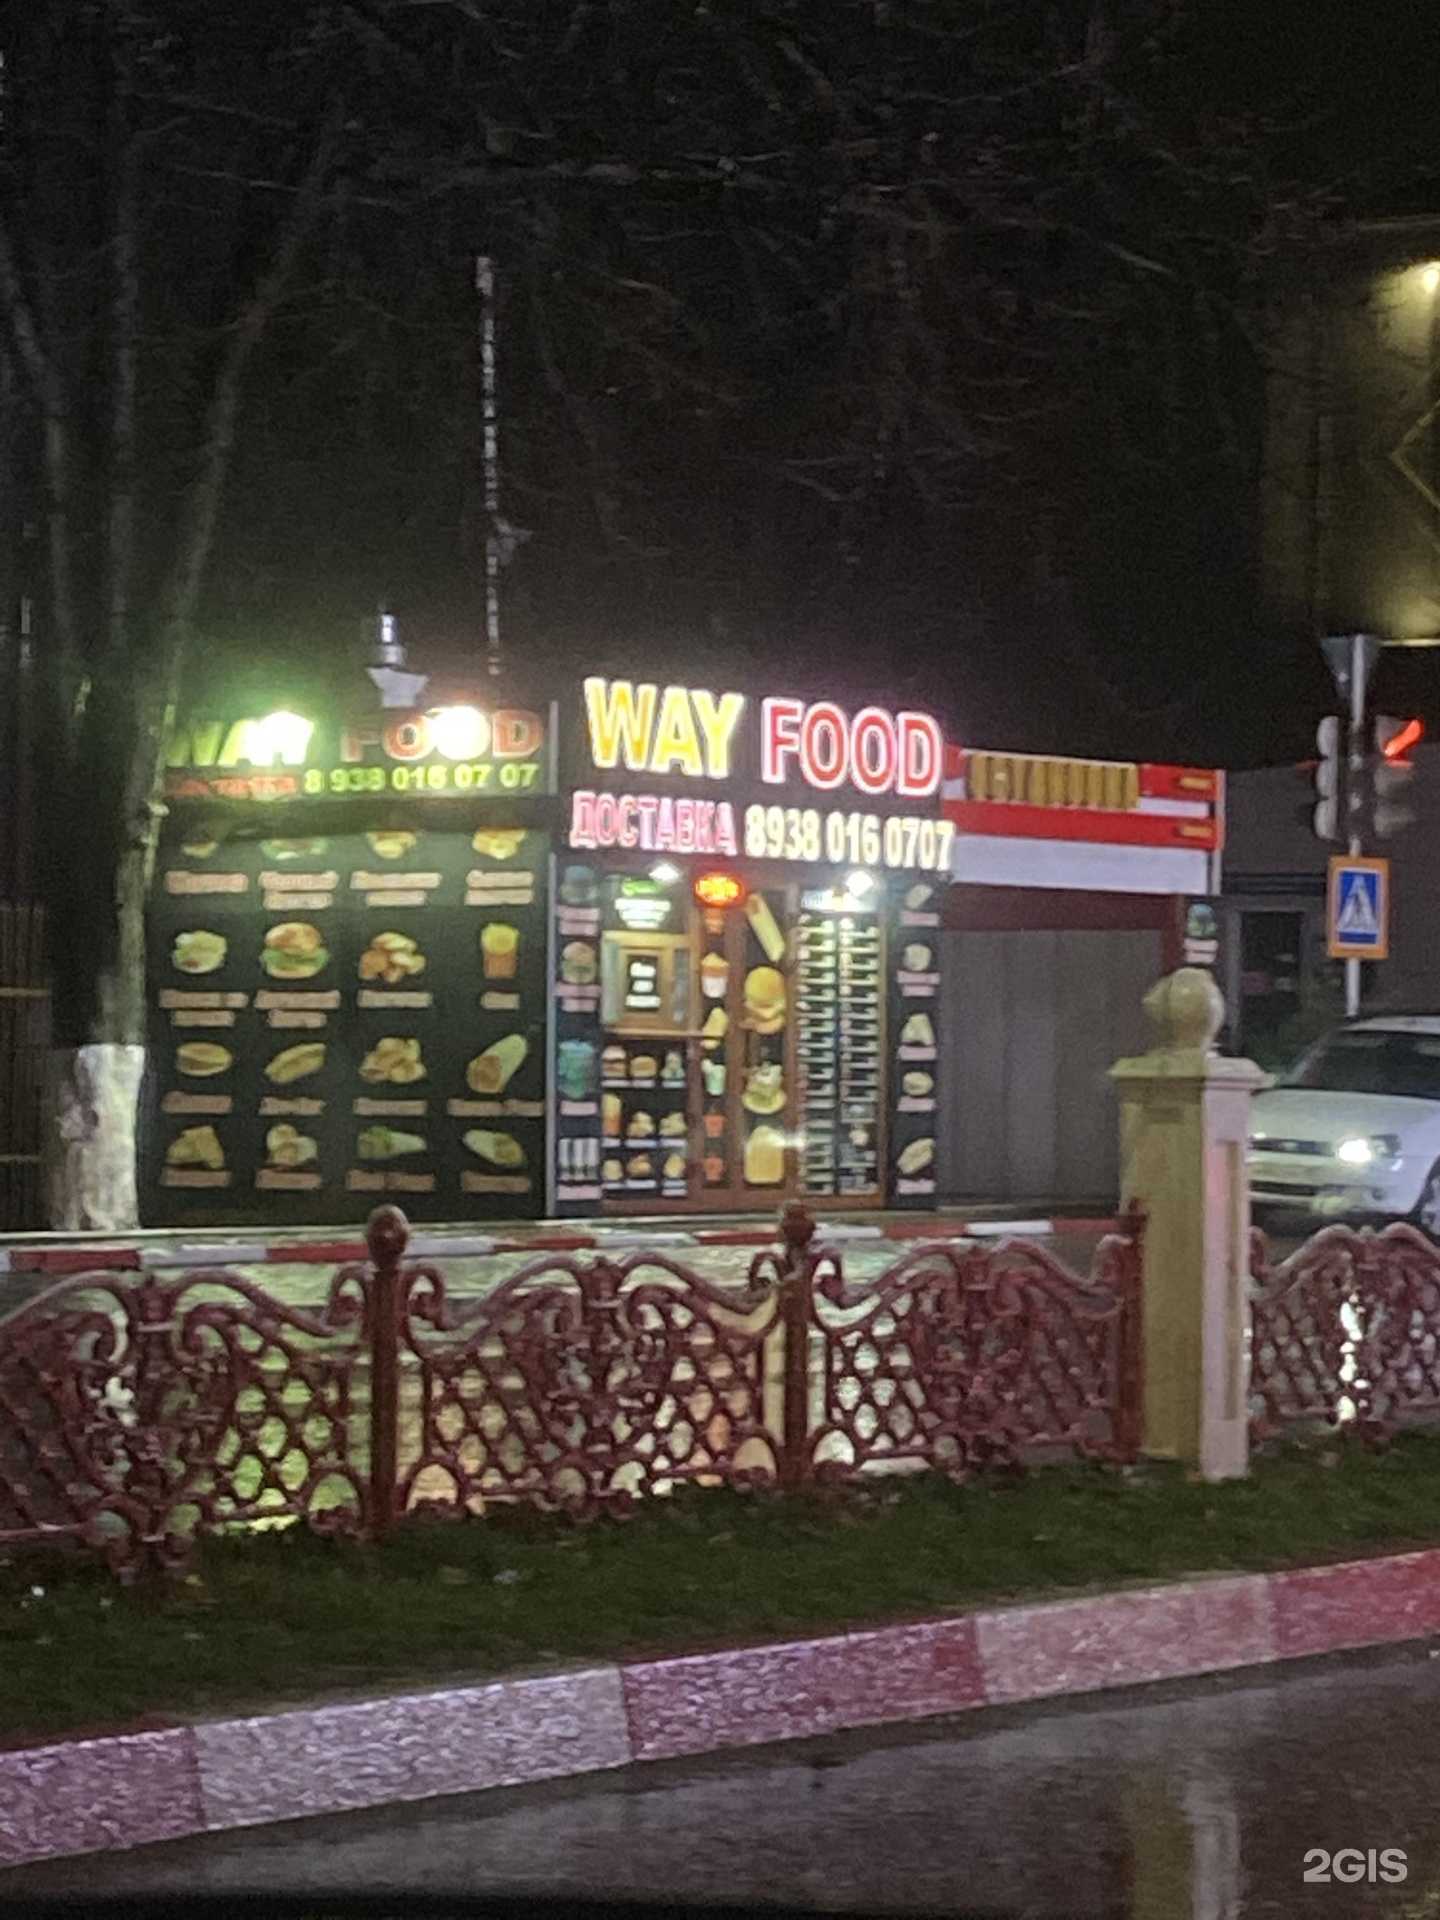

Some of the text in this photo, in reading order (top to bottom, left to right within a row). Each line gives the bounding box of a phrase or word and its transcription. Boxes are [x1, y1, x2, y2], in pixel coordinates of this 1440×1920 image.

[304, 768, 324, 793] 8
[391, 764, 446, 791] 016
[453, 764, 491, 788] 07
[500, 762, 540, 787] 07
[584, 677, 745, 779] WAY
[761, 696, 943, 798] FOOD
[569, 790, 956, 871] ДОСТАВКА 8938 016 0707
